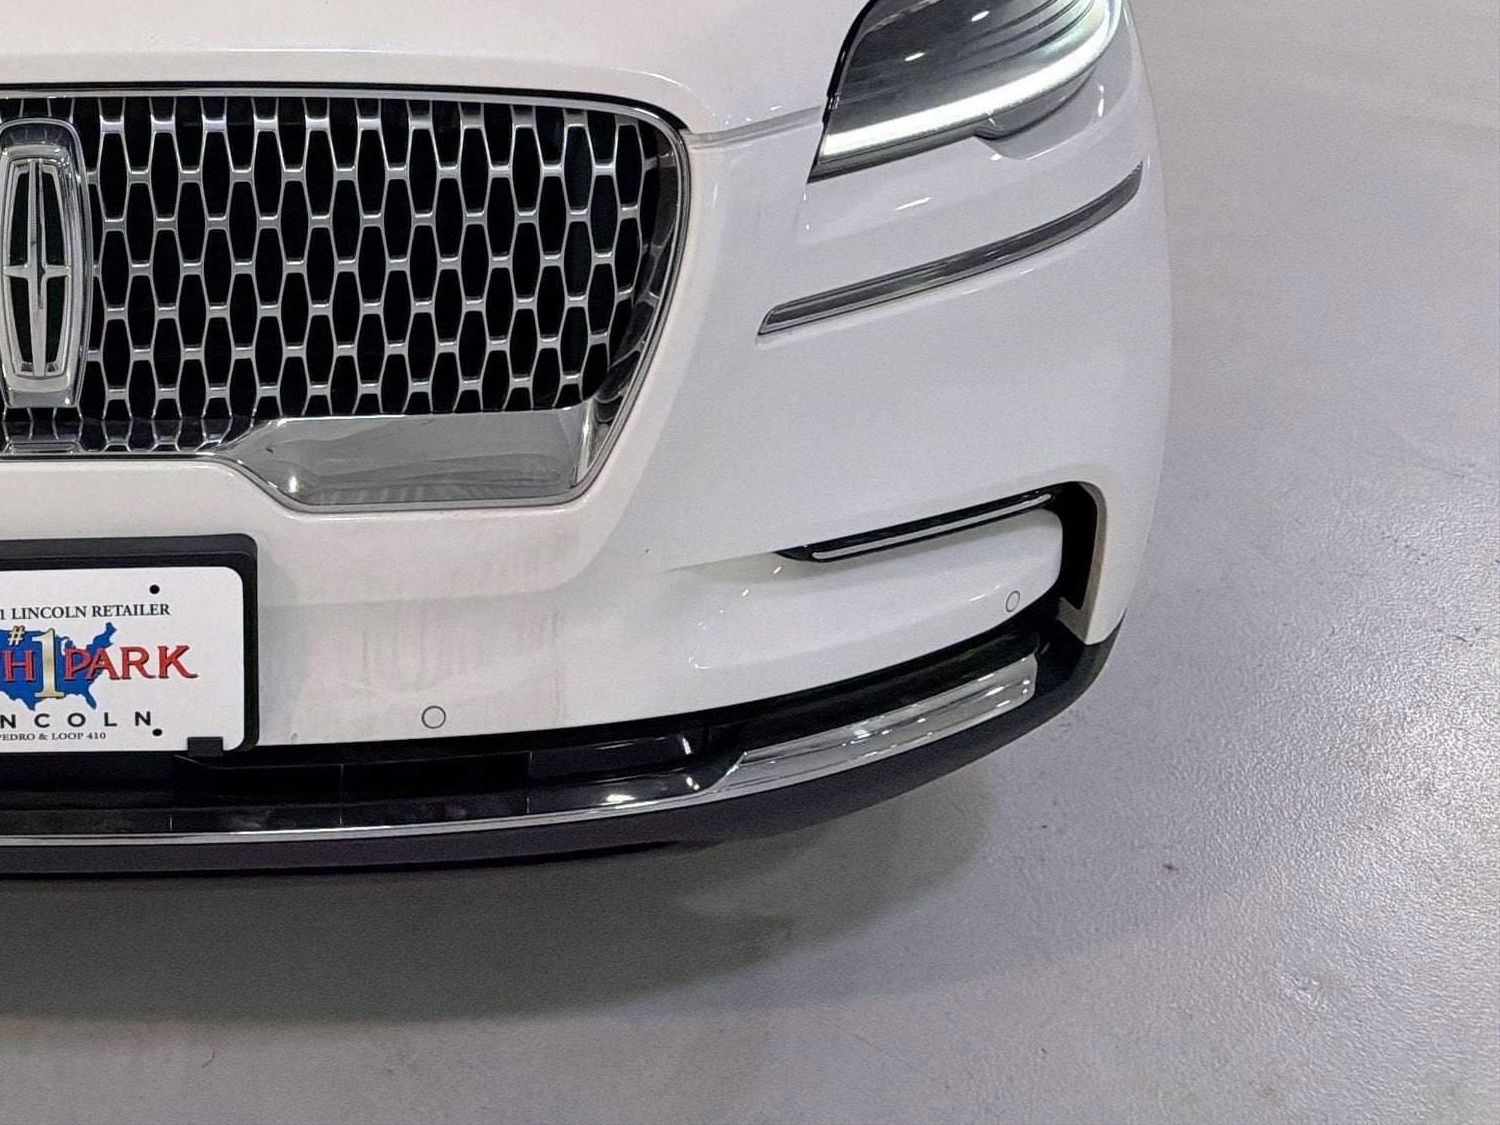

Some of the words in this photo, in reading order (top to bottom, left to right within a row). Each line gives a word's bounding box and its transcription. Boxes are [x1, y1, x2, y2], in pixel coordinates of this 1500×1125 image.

[11, 606, 87, 621] LINCOLN
[92, 603, 172, 618] RETAILER
[63, 645, 200, 682] PARK
[38, 732, 49, 741] &
[51, 731, 84, 741] LOOP
[86, 731, 107, 740] 410
